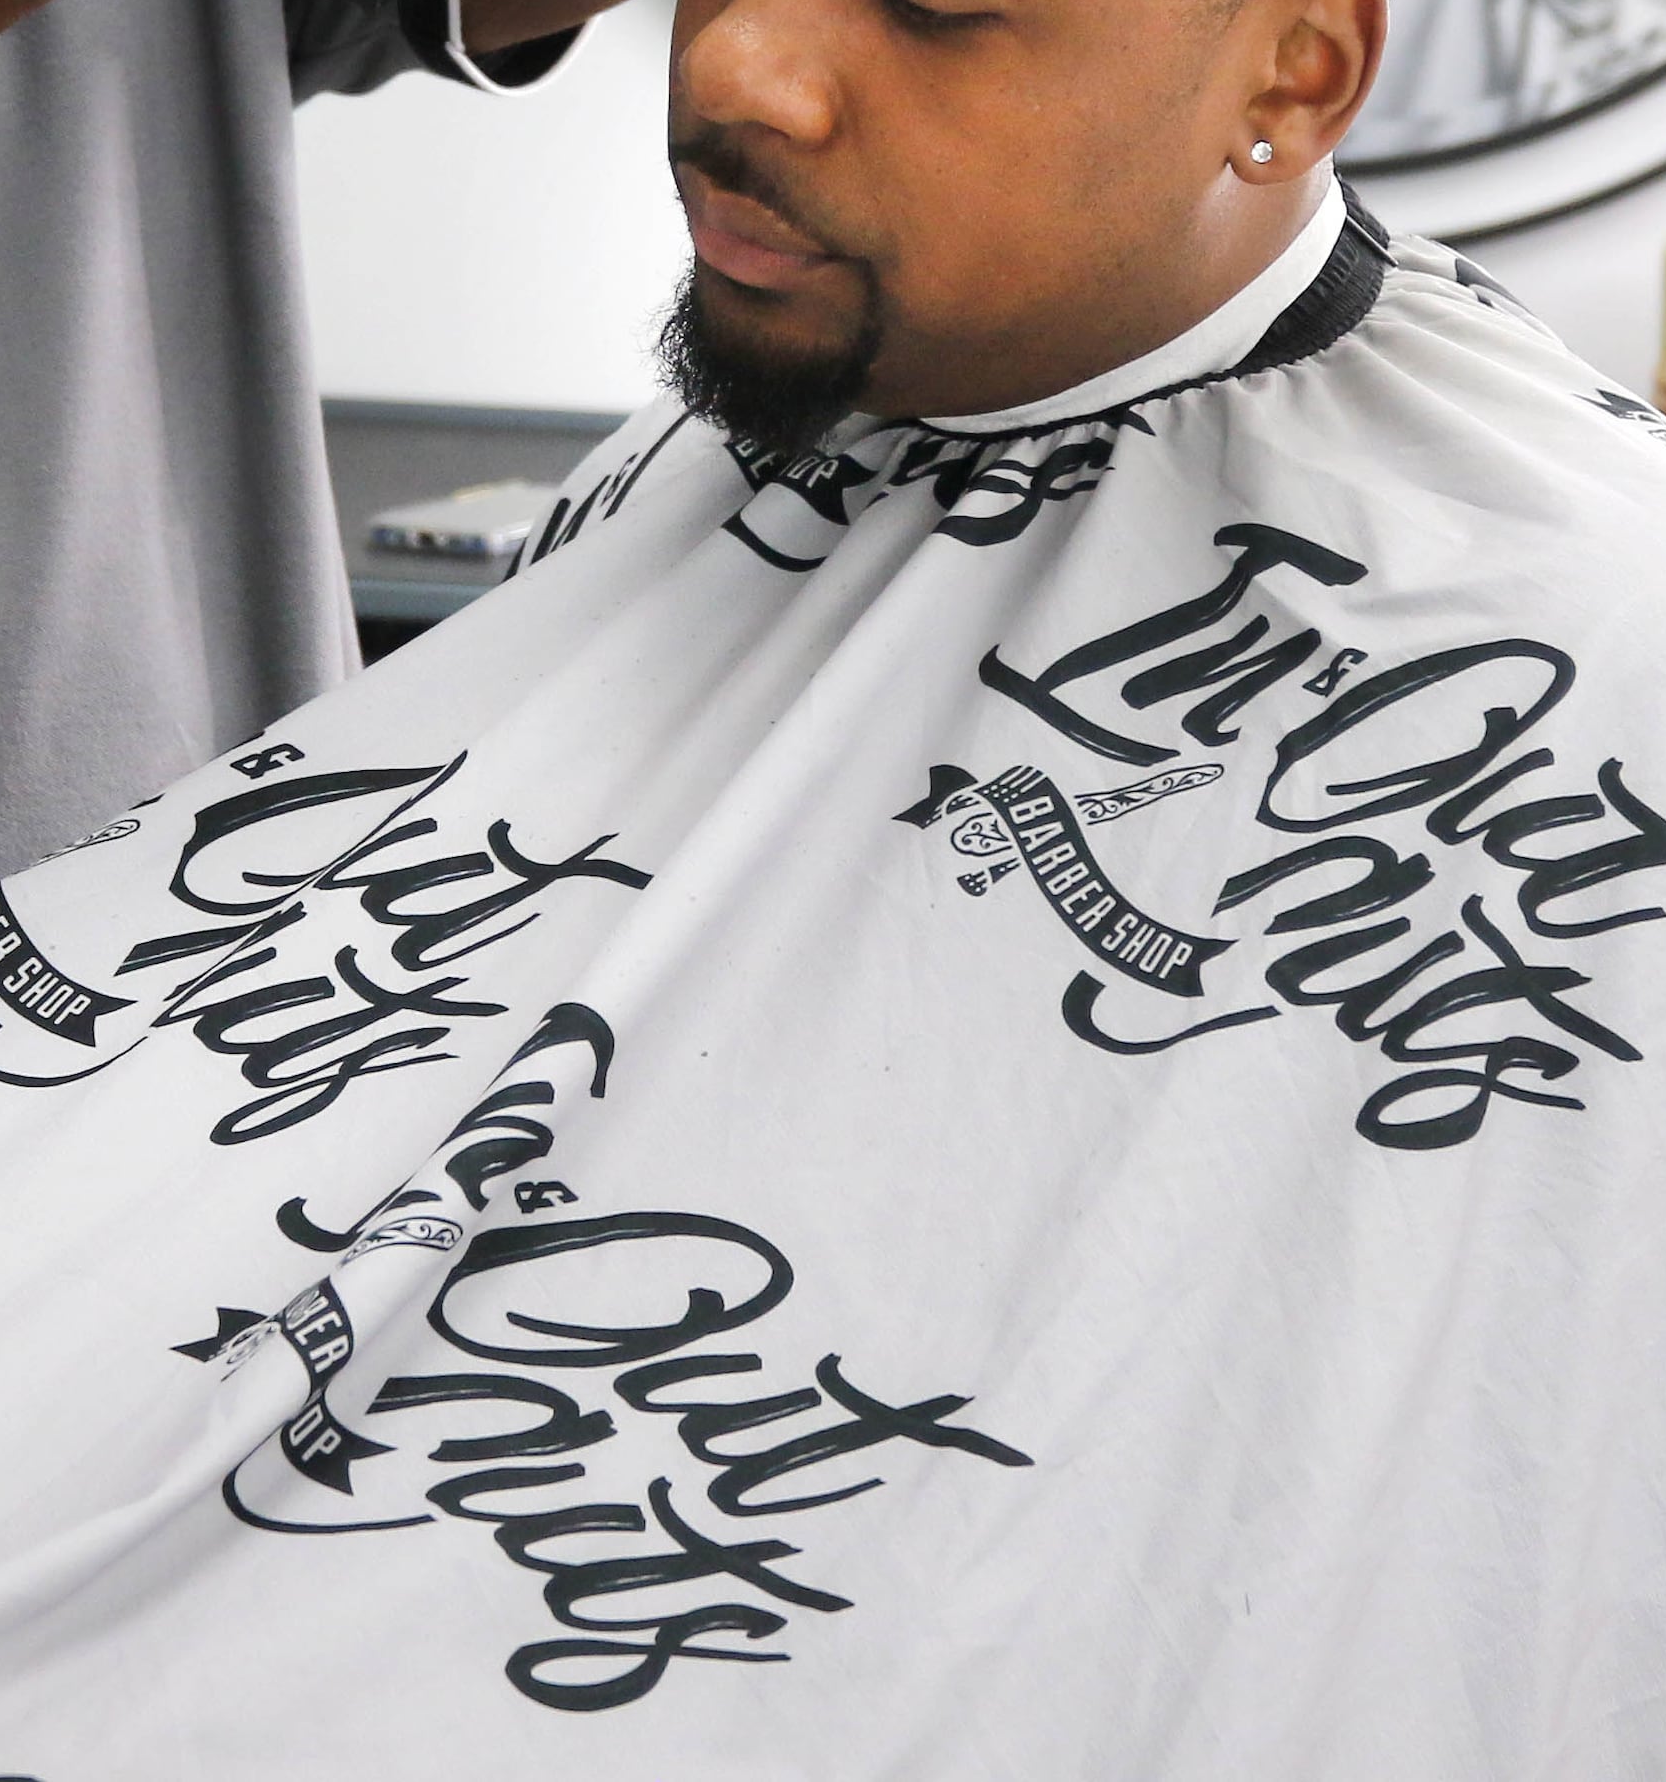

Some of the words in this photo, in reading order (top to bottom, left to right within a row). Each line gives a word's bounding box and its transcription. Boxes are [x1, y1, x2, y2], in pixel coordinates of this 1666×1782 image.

[979, 521, 1369, 767] In
[2, 956, 92, 1025] SHOP
[1008, 795, 1117, 933] BARBER
[1100, 912, 1193, 979] SHOP
[426, 1210, 1036, 1518] Out
